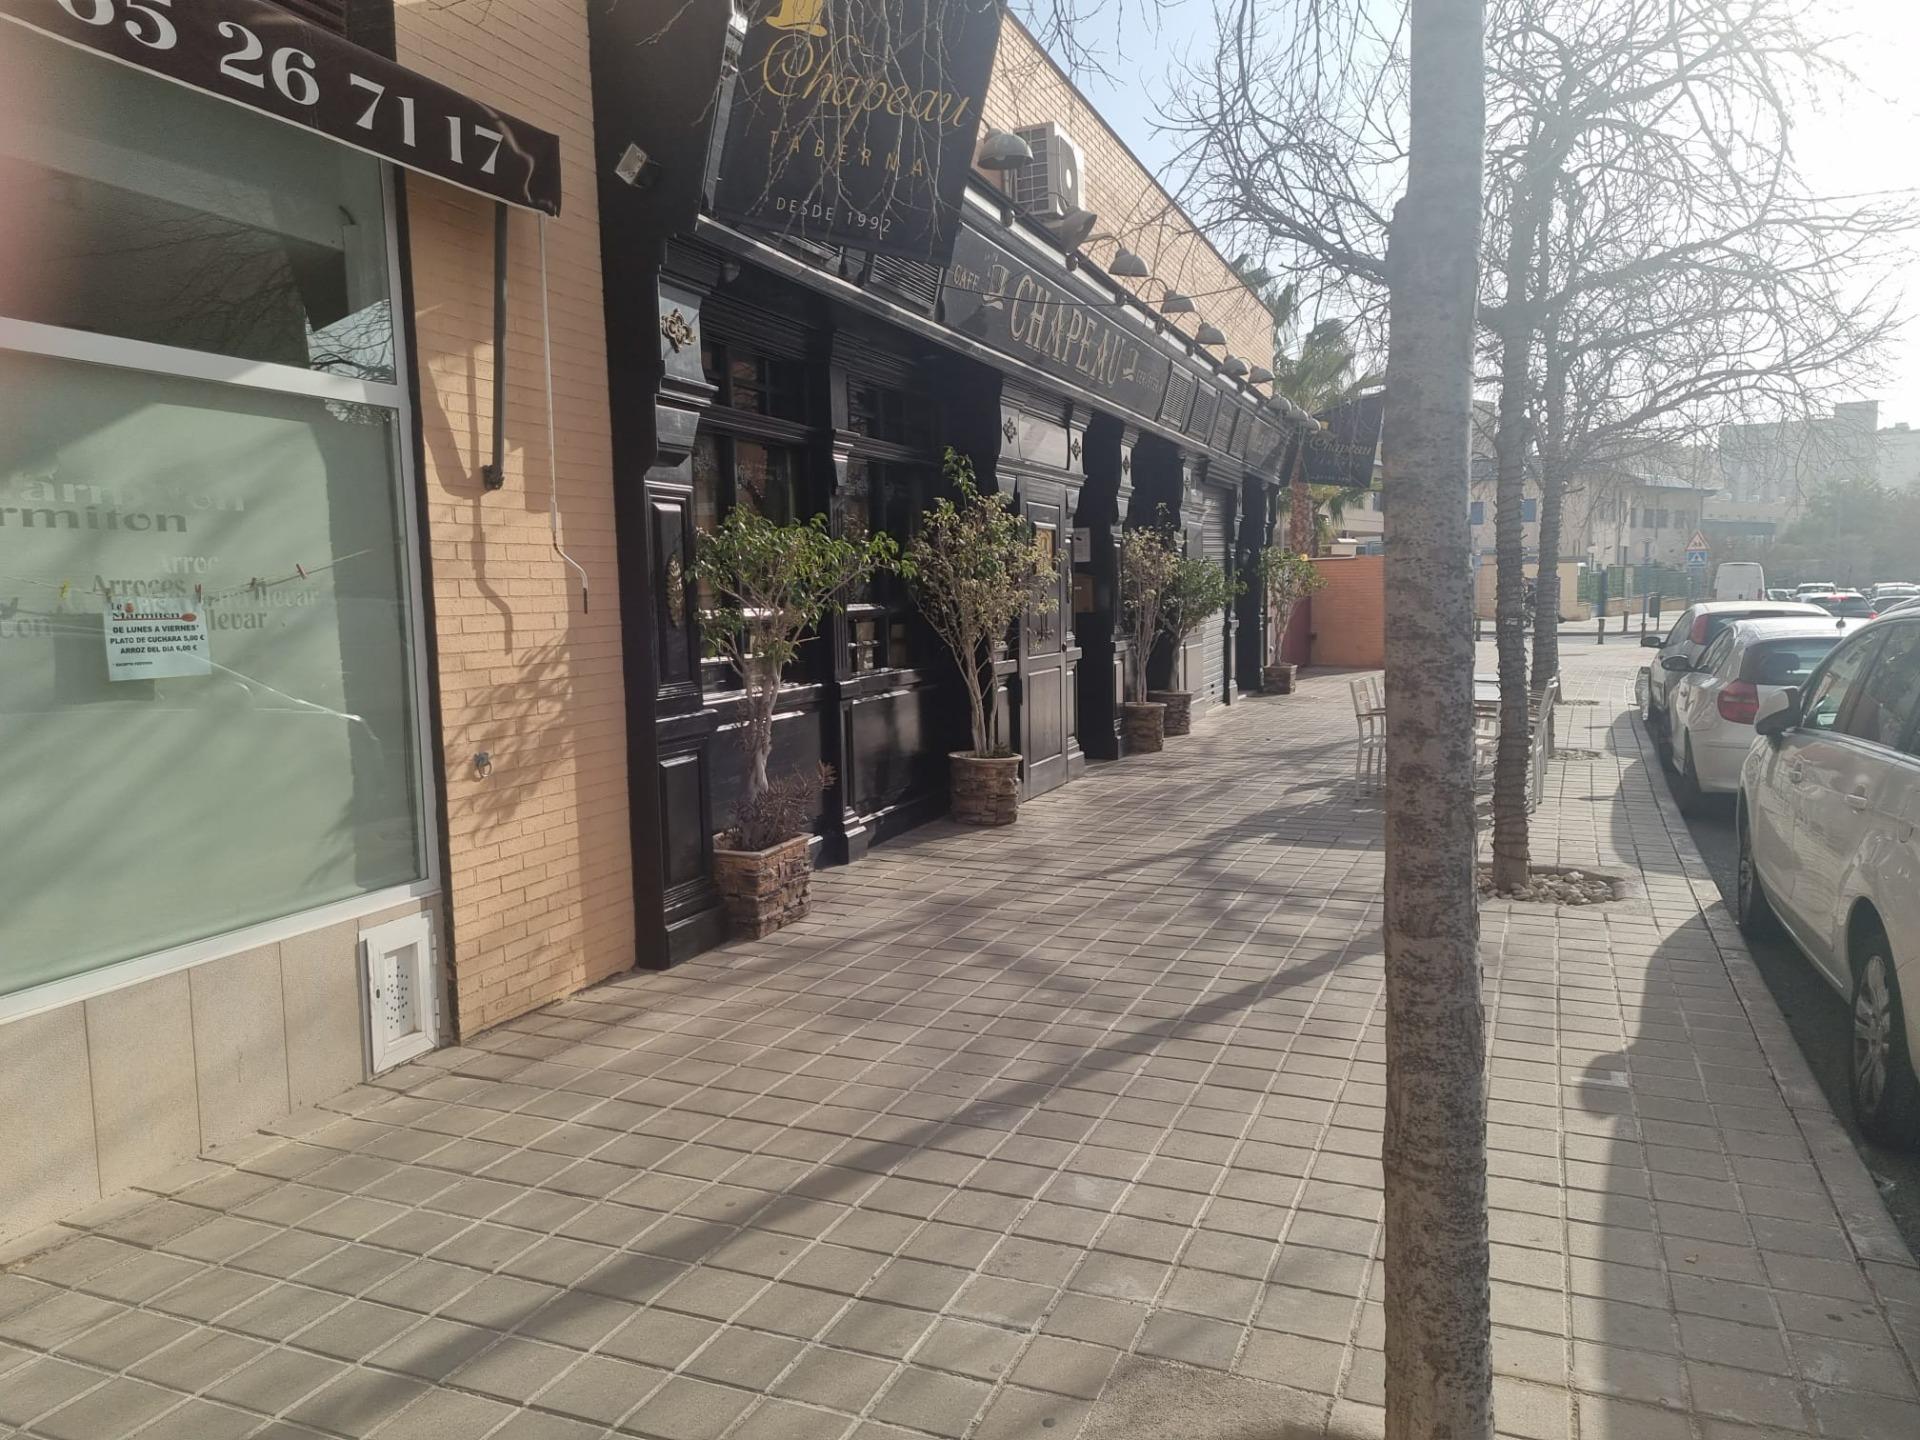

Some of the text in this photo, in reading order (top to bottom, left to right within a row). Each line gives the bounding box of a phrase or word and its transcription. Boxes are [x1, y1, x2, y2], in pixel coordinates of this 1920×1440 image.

[218, 21, 319, 106] 26
[770, 130, 923, 178] TABERNA
[776, 197, 892, 233] DESDE 1992
[1011, 274, 1127, 389] CHAPEAU
[109, 637, 136, 645] PLATO
[147, 635, 182, 643] CUCHARA
[112, 625, 125, 634] DE
[126, 624, 153, 633] LUNES
[154, 625, 160, 633] A
[120, 647, 146, 655] ARROZ
